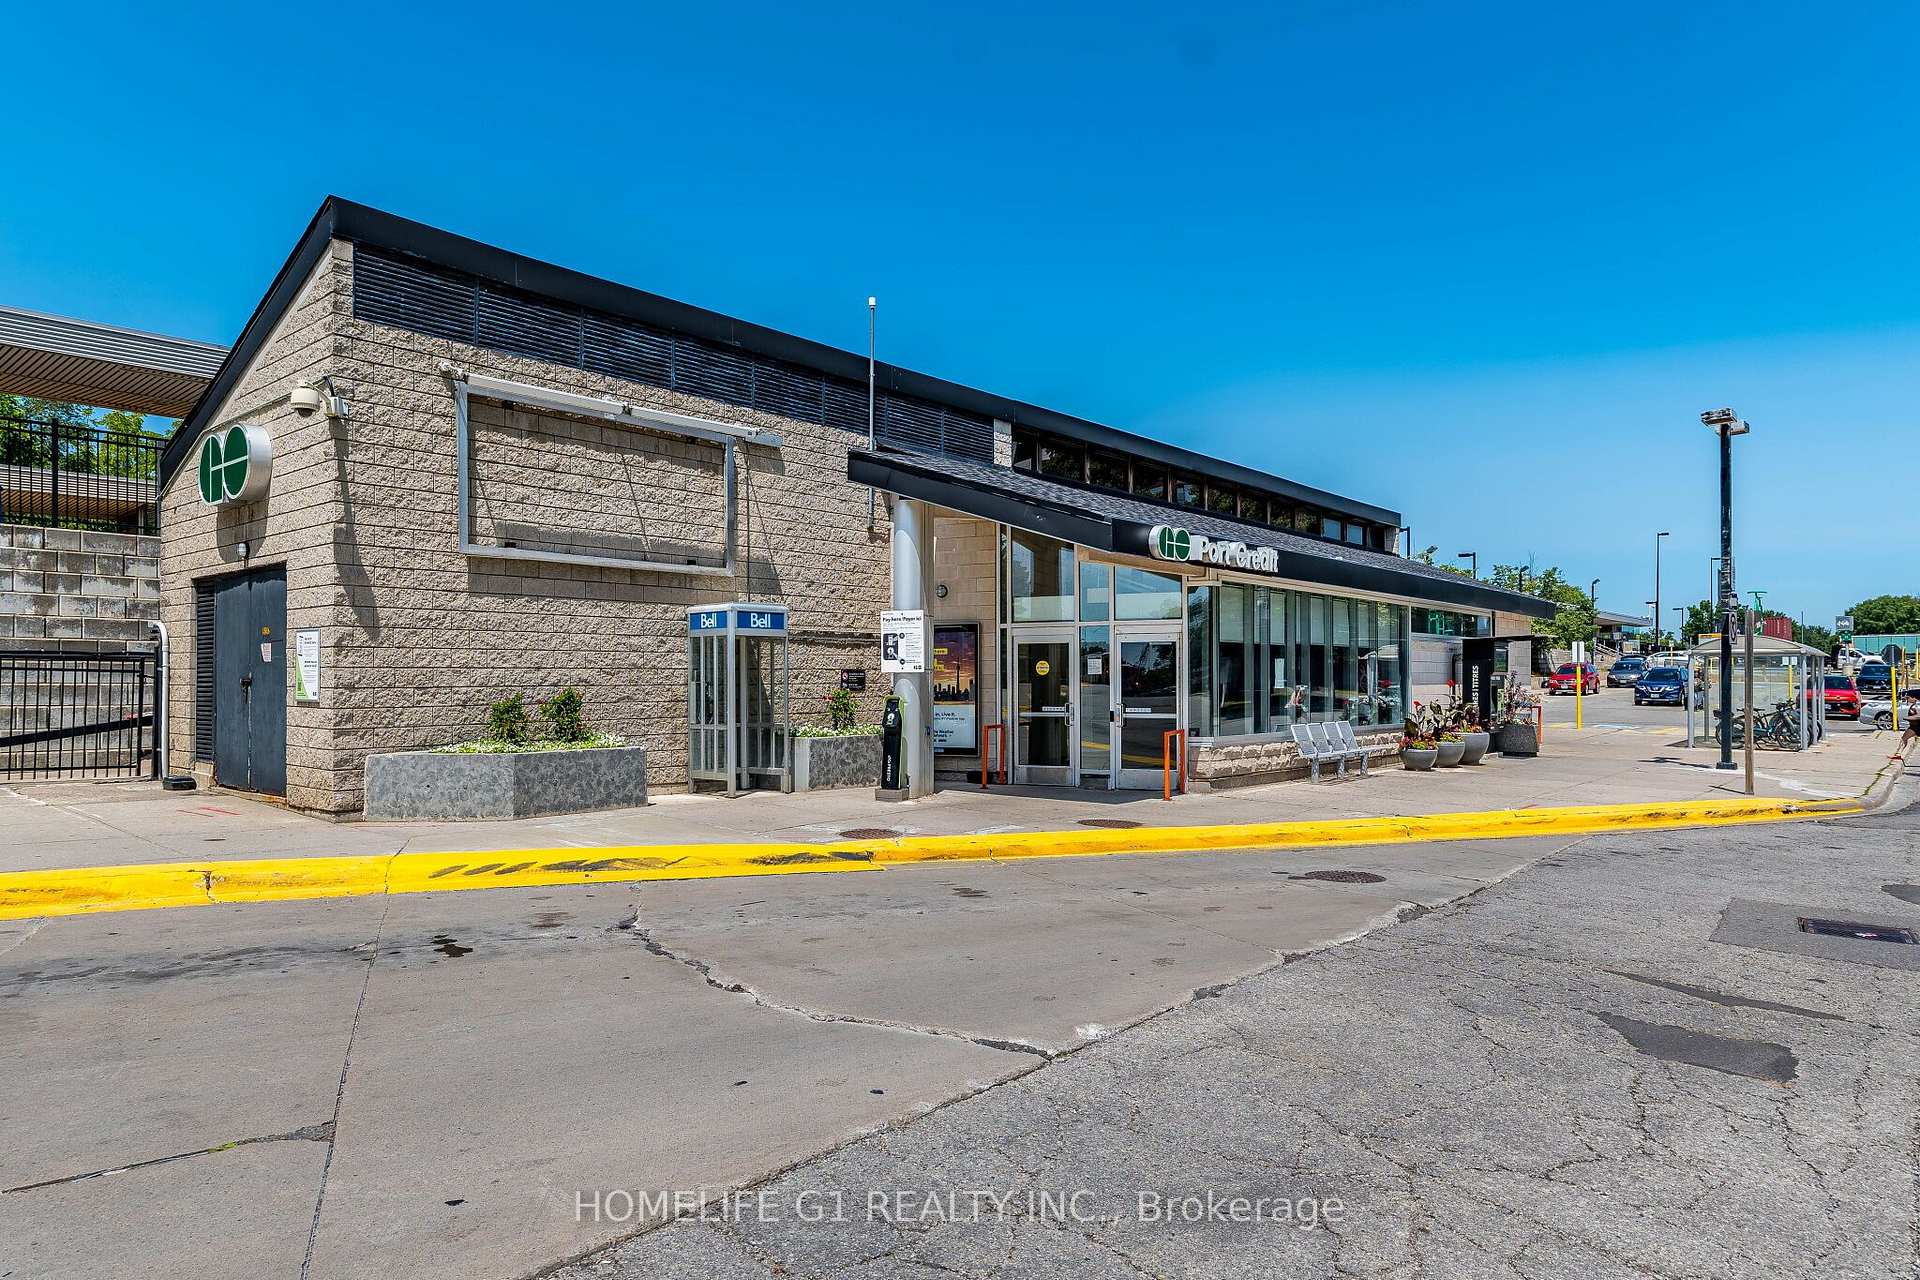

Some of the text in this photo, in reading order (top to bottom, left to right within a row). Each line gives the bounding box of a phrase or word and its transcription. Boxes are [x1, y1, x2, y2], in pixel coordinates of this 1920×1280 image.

[1200, 536, 1231, 565] Port
[1236, 541, 1279, 573] Credit
[700, 613, 717, 629] Bell
[750, 613, 771, 629] Bell
